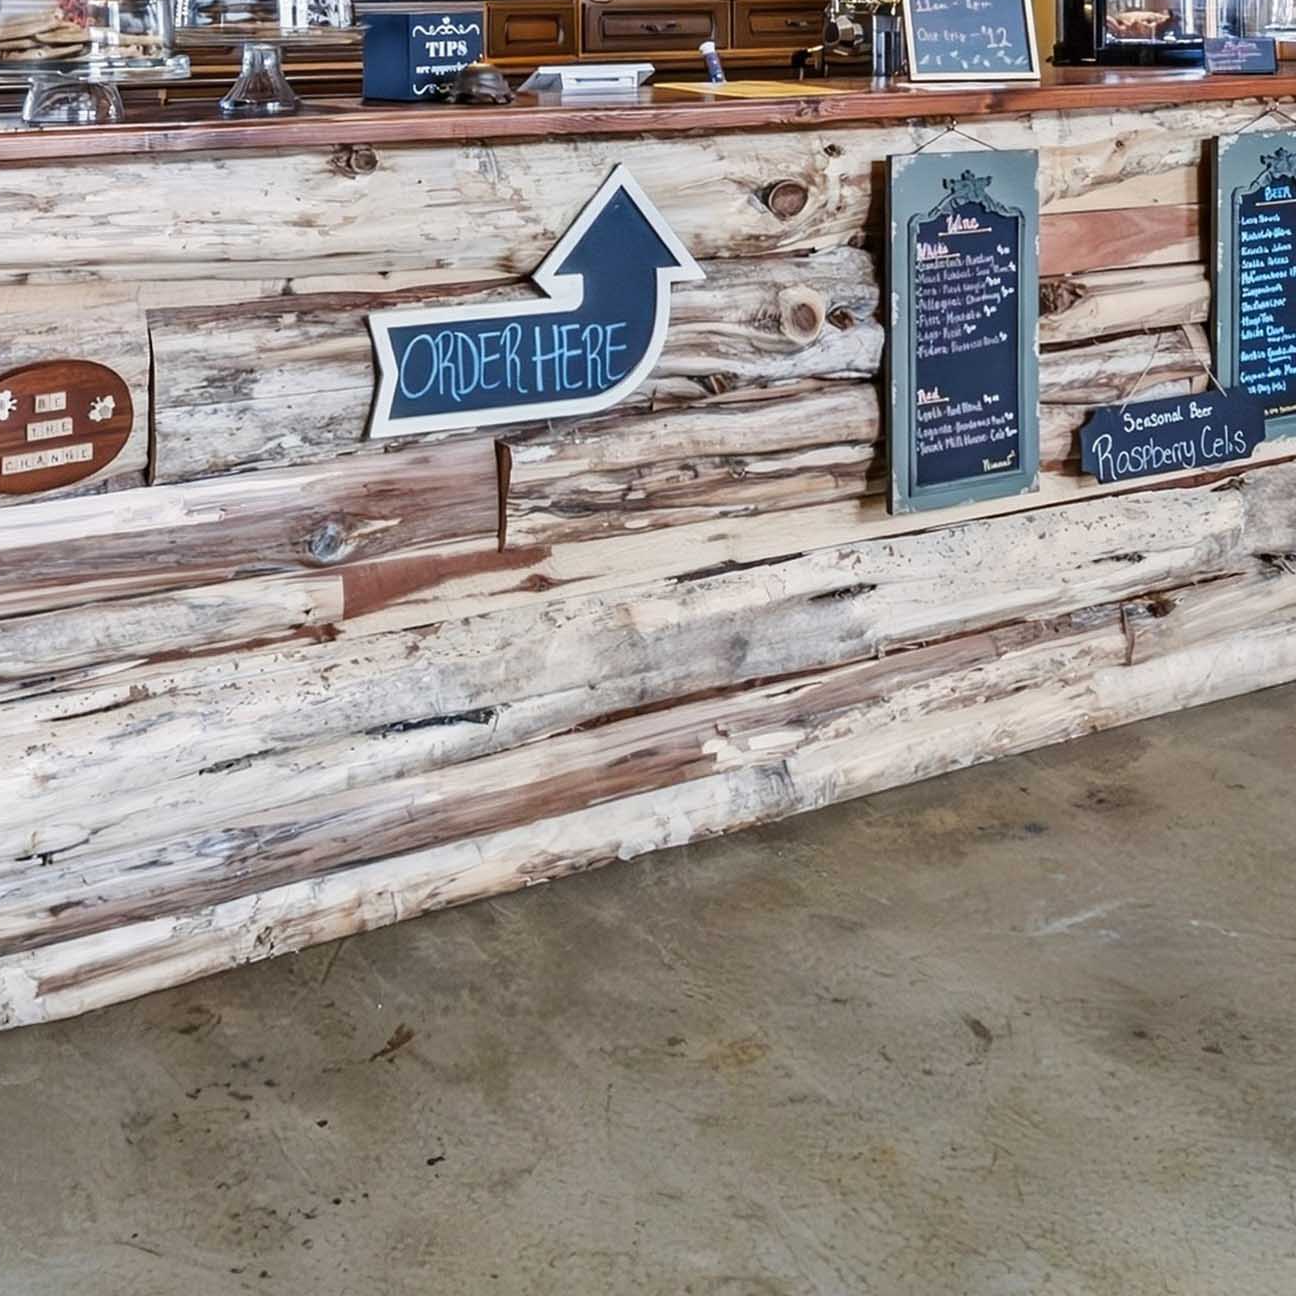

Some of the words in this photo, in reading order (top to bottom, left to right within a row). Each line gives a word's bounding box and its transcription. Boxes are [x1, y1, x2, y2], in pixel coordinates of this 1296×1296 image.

[425, 40, 468, 58] TIPS
[399, 321, 529, 403] ORDER
[531, 321, 627, 392] HERE
[1123, 406, 1184, 433] Seasonal
[1189, 401, 1214, 419] Beer
[1091, 432, 1197, 481] Raspberry
